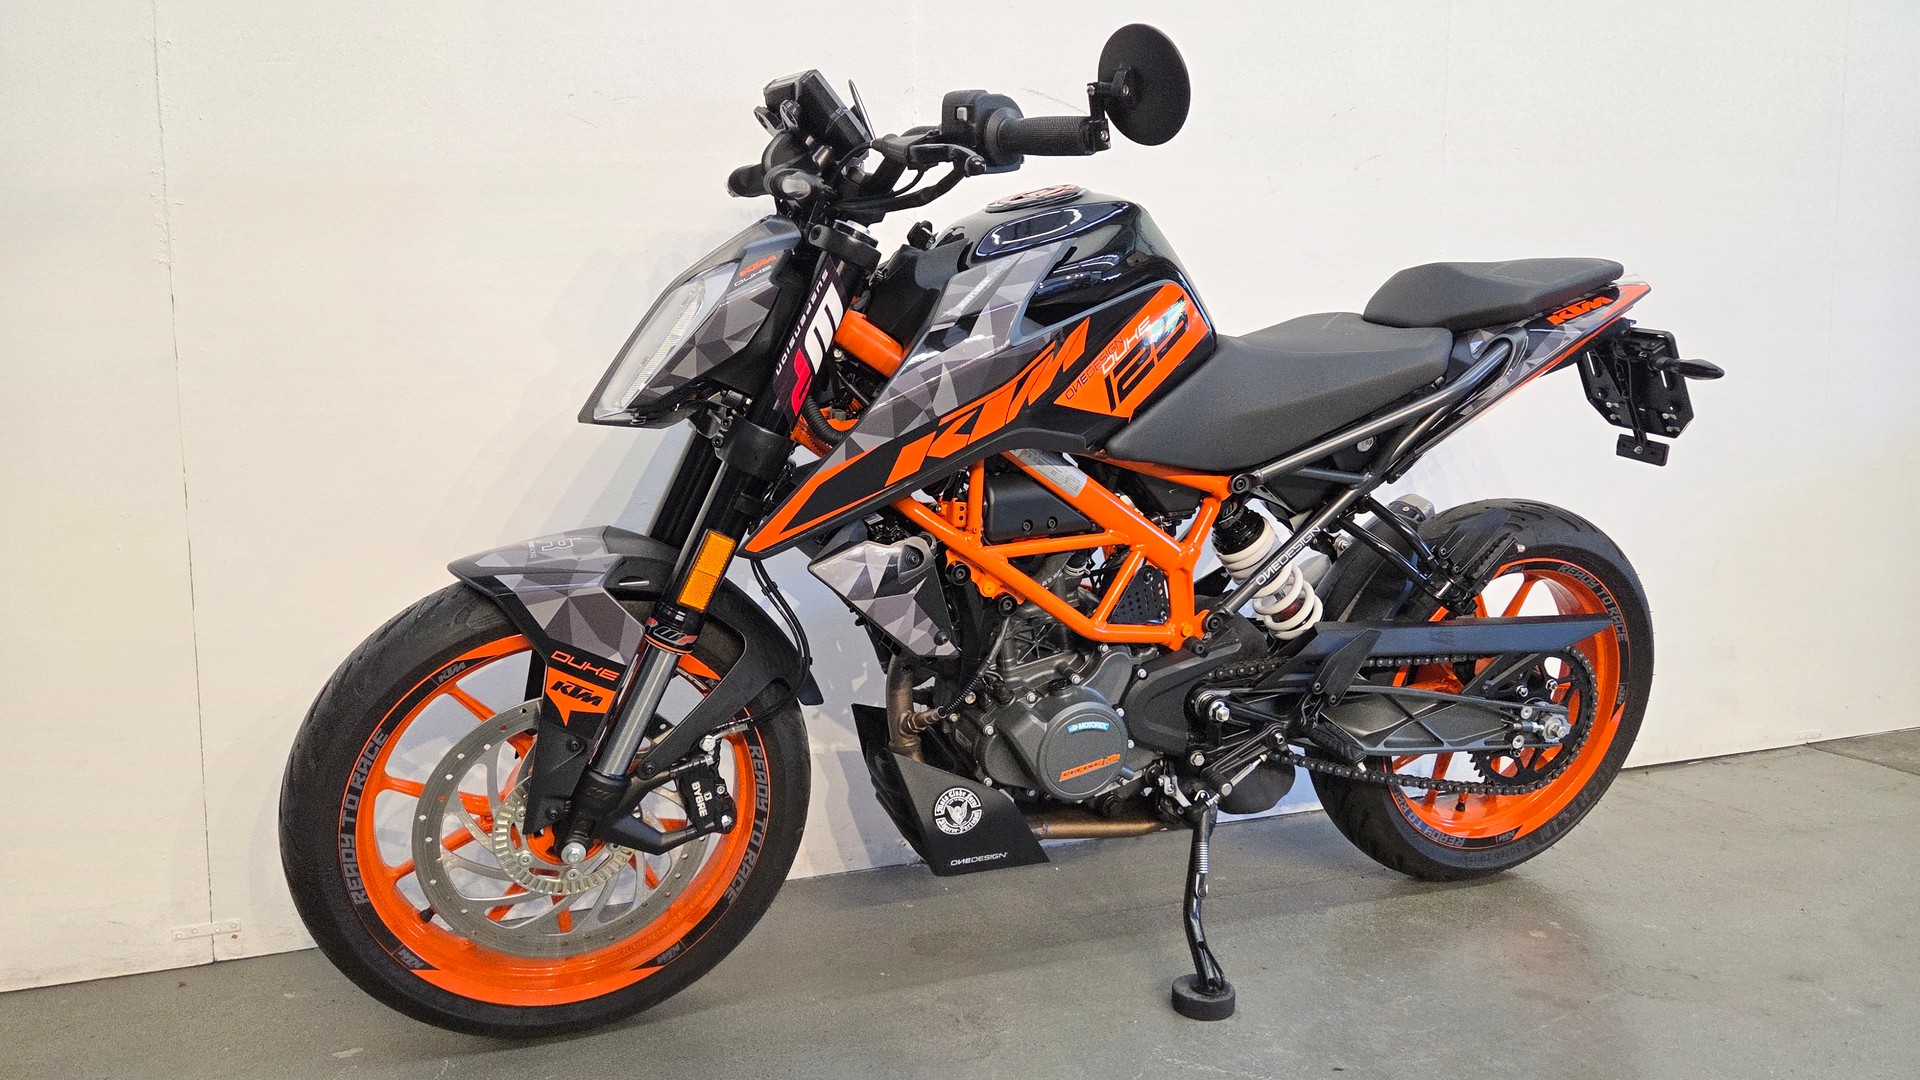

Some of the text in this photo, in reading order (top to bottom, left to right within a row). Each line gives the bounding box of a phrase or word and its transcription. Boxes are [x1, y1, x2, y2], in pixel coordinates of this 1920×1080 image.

[739, 255, 777, 277] KTM
[1546, 296, 1614, 326] KTM
[1104, 294, 1189, 413] 125
[885, 316, 1091, 487] KTM
[1256, 524, 1321, 586] ONEDESIGN
[1558, 563, 1599, 589] READY
[1596, 587, 1611, 606] TO
[438, 661, 467, 683] KTM
[550, 650, 621, 682] DUKE
[550, 680, 604, 707] KTM
[691, 780, 708, 818] BYBRE
[340, 727, 389, 905] READY TO RACE
[724, 745, 769, 904] READY TO RACE
[1407, 812, 1424, 830] TO
[1424, 828, 1466, 847] READY
[950, 852, 1008, 867] ONEDESIGN
[398, 948, 425, 969] KTM
